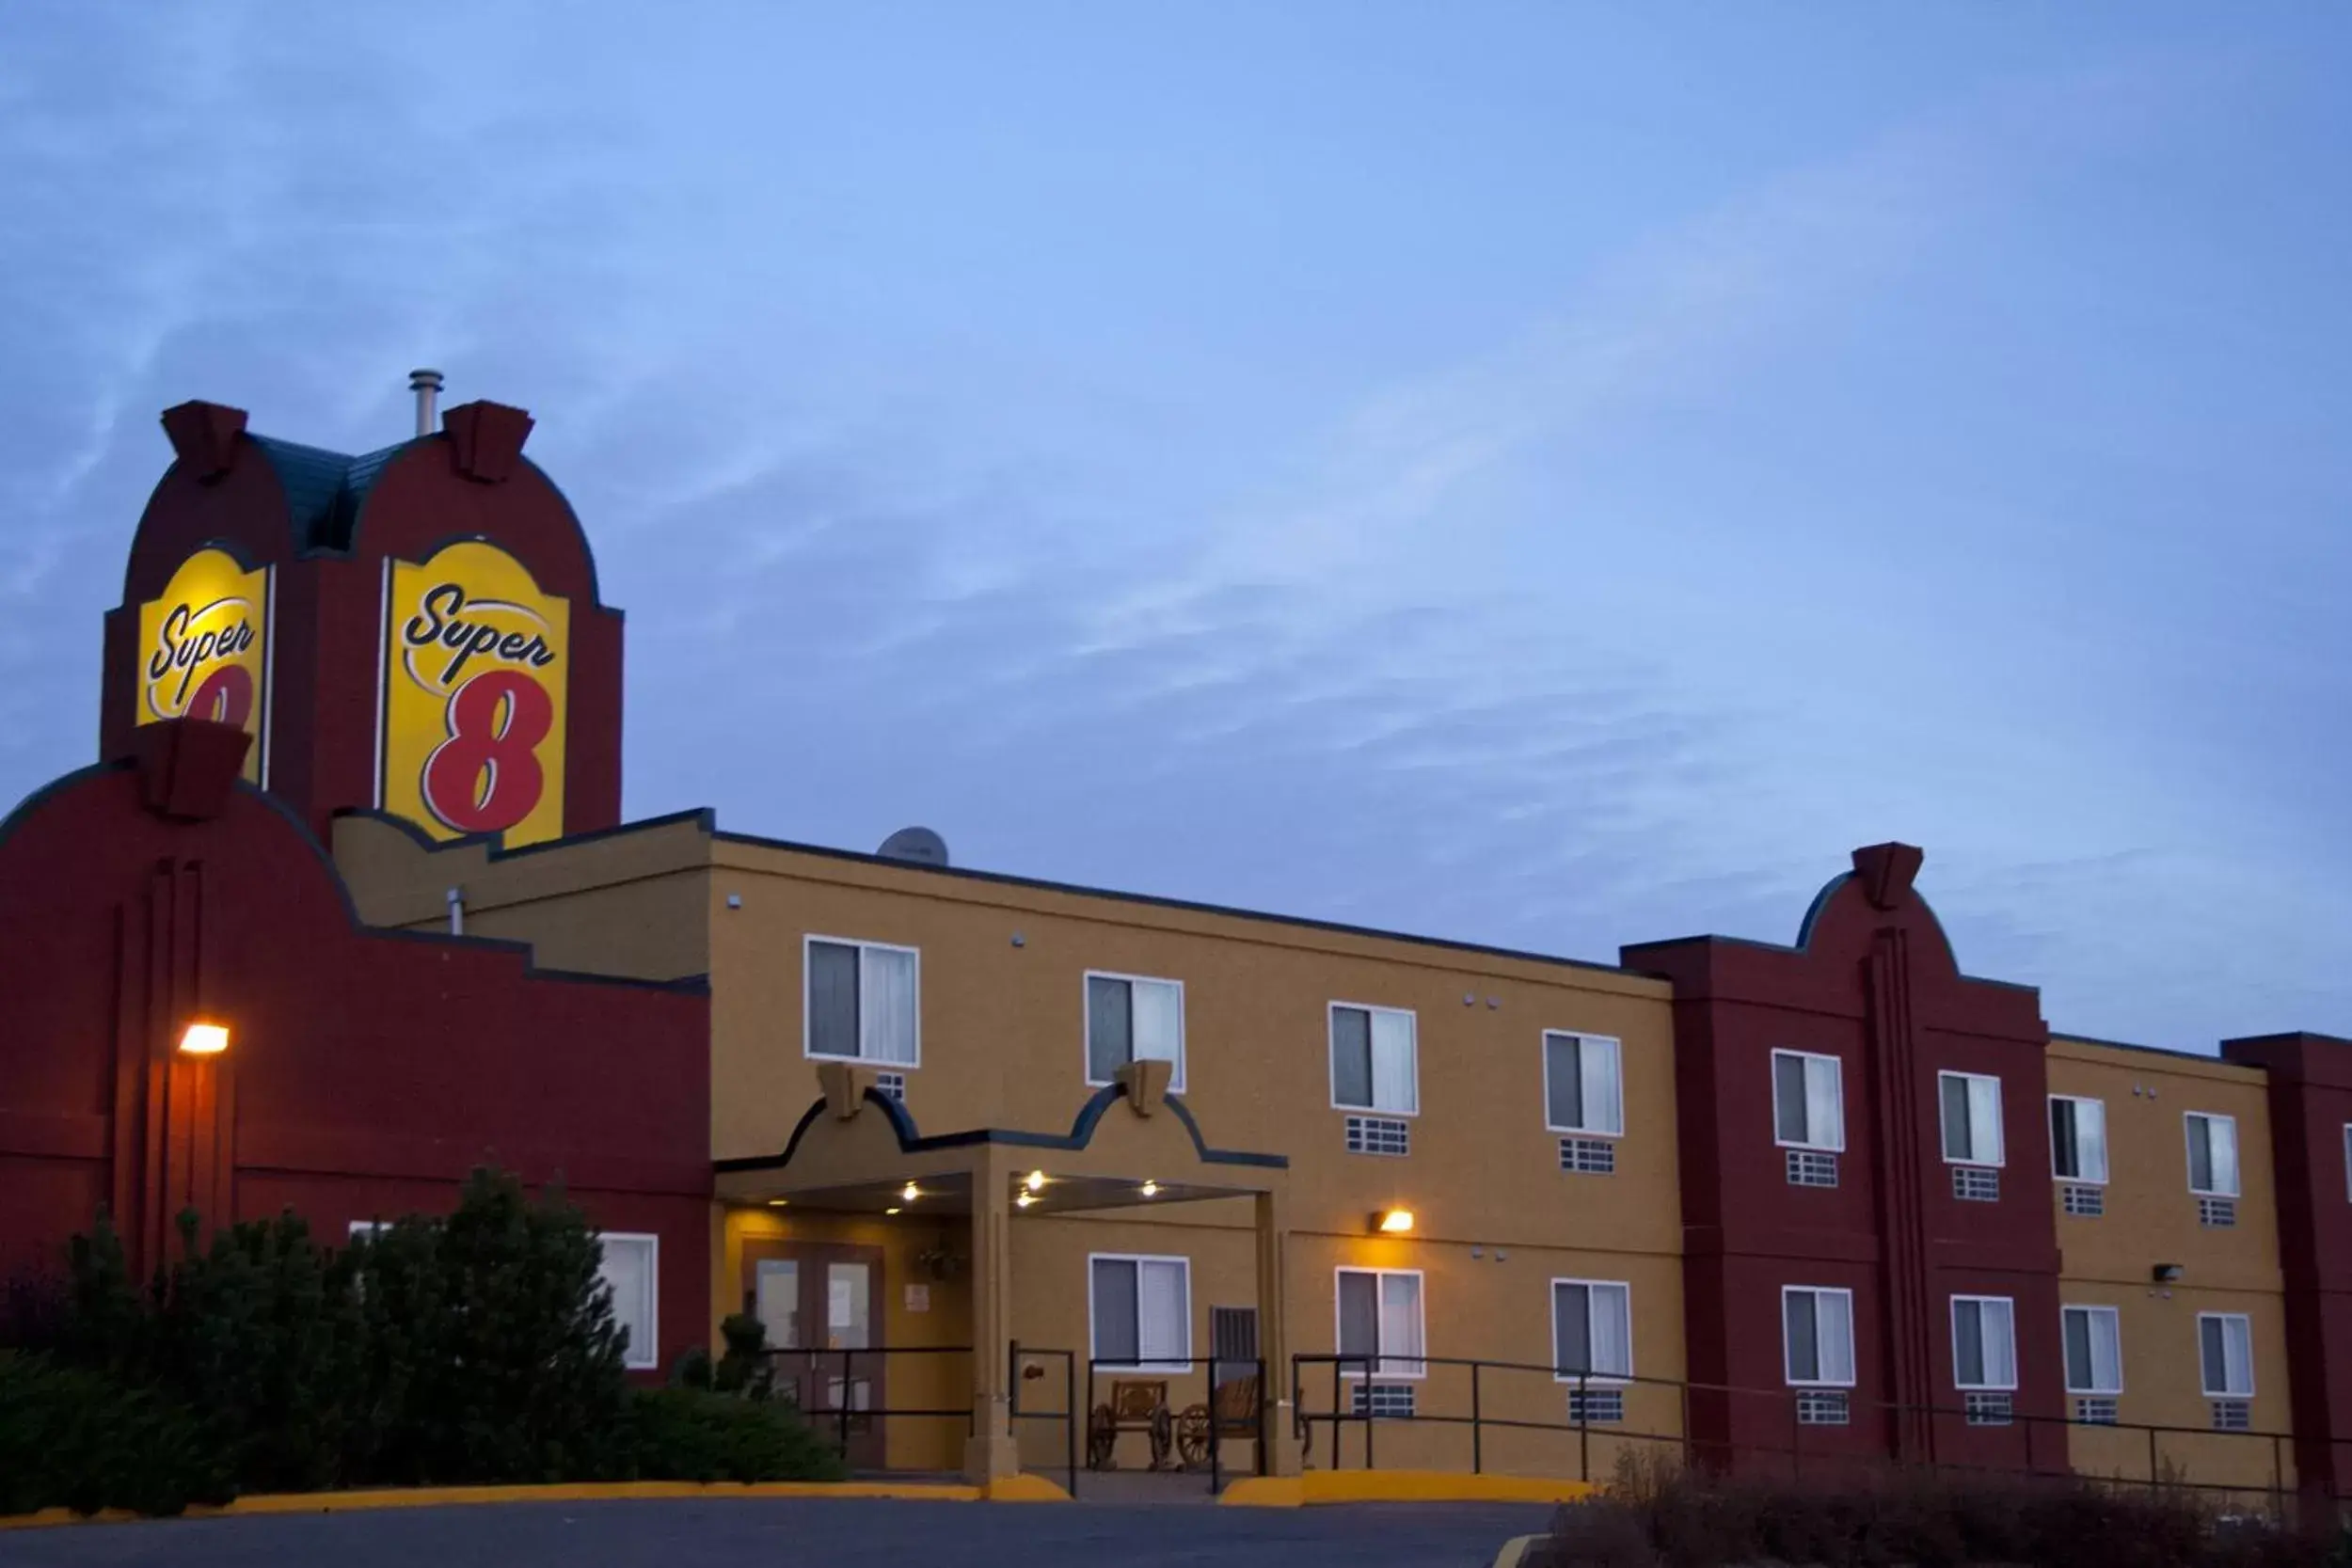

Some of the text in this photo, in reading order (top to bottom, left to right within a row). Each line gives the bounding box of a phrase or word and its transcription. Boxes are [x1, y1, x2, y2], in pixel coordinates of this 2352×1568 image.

[150, 603, 256, 705] Super
[405, 583, 556, 686] Super
[421, 669, 553, 833] 8
